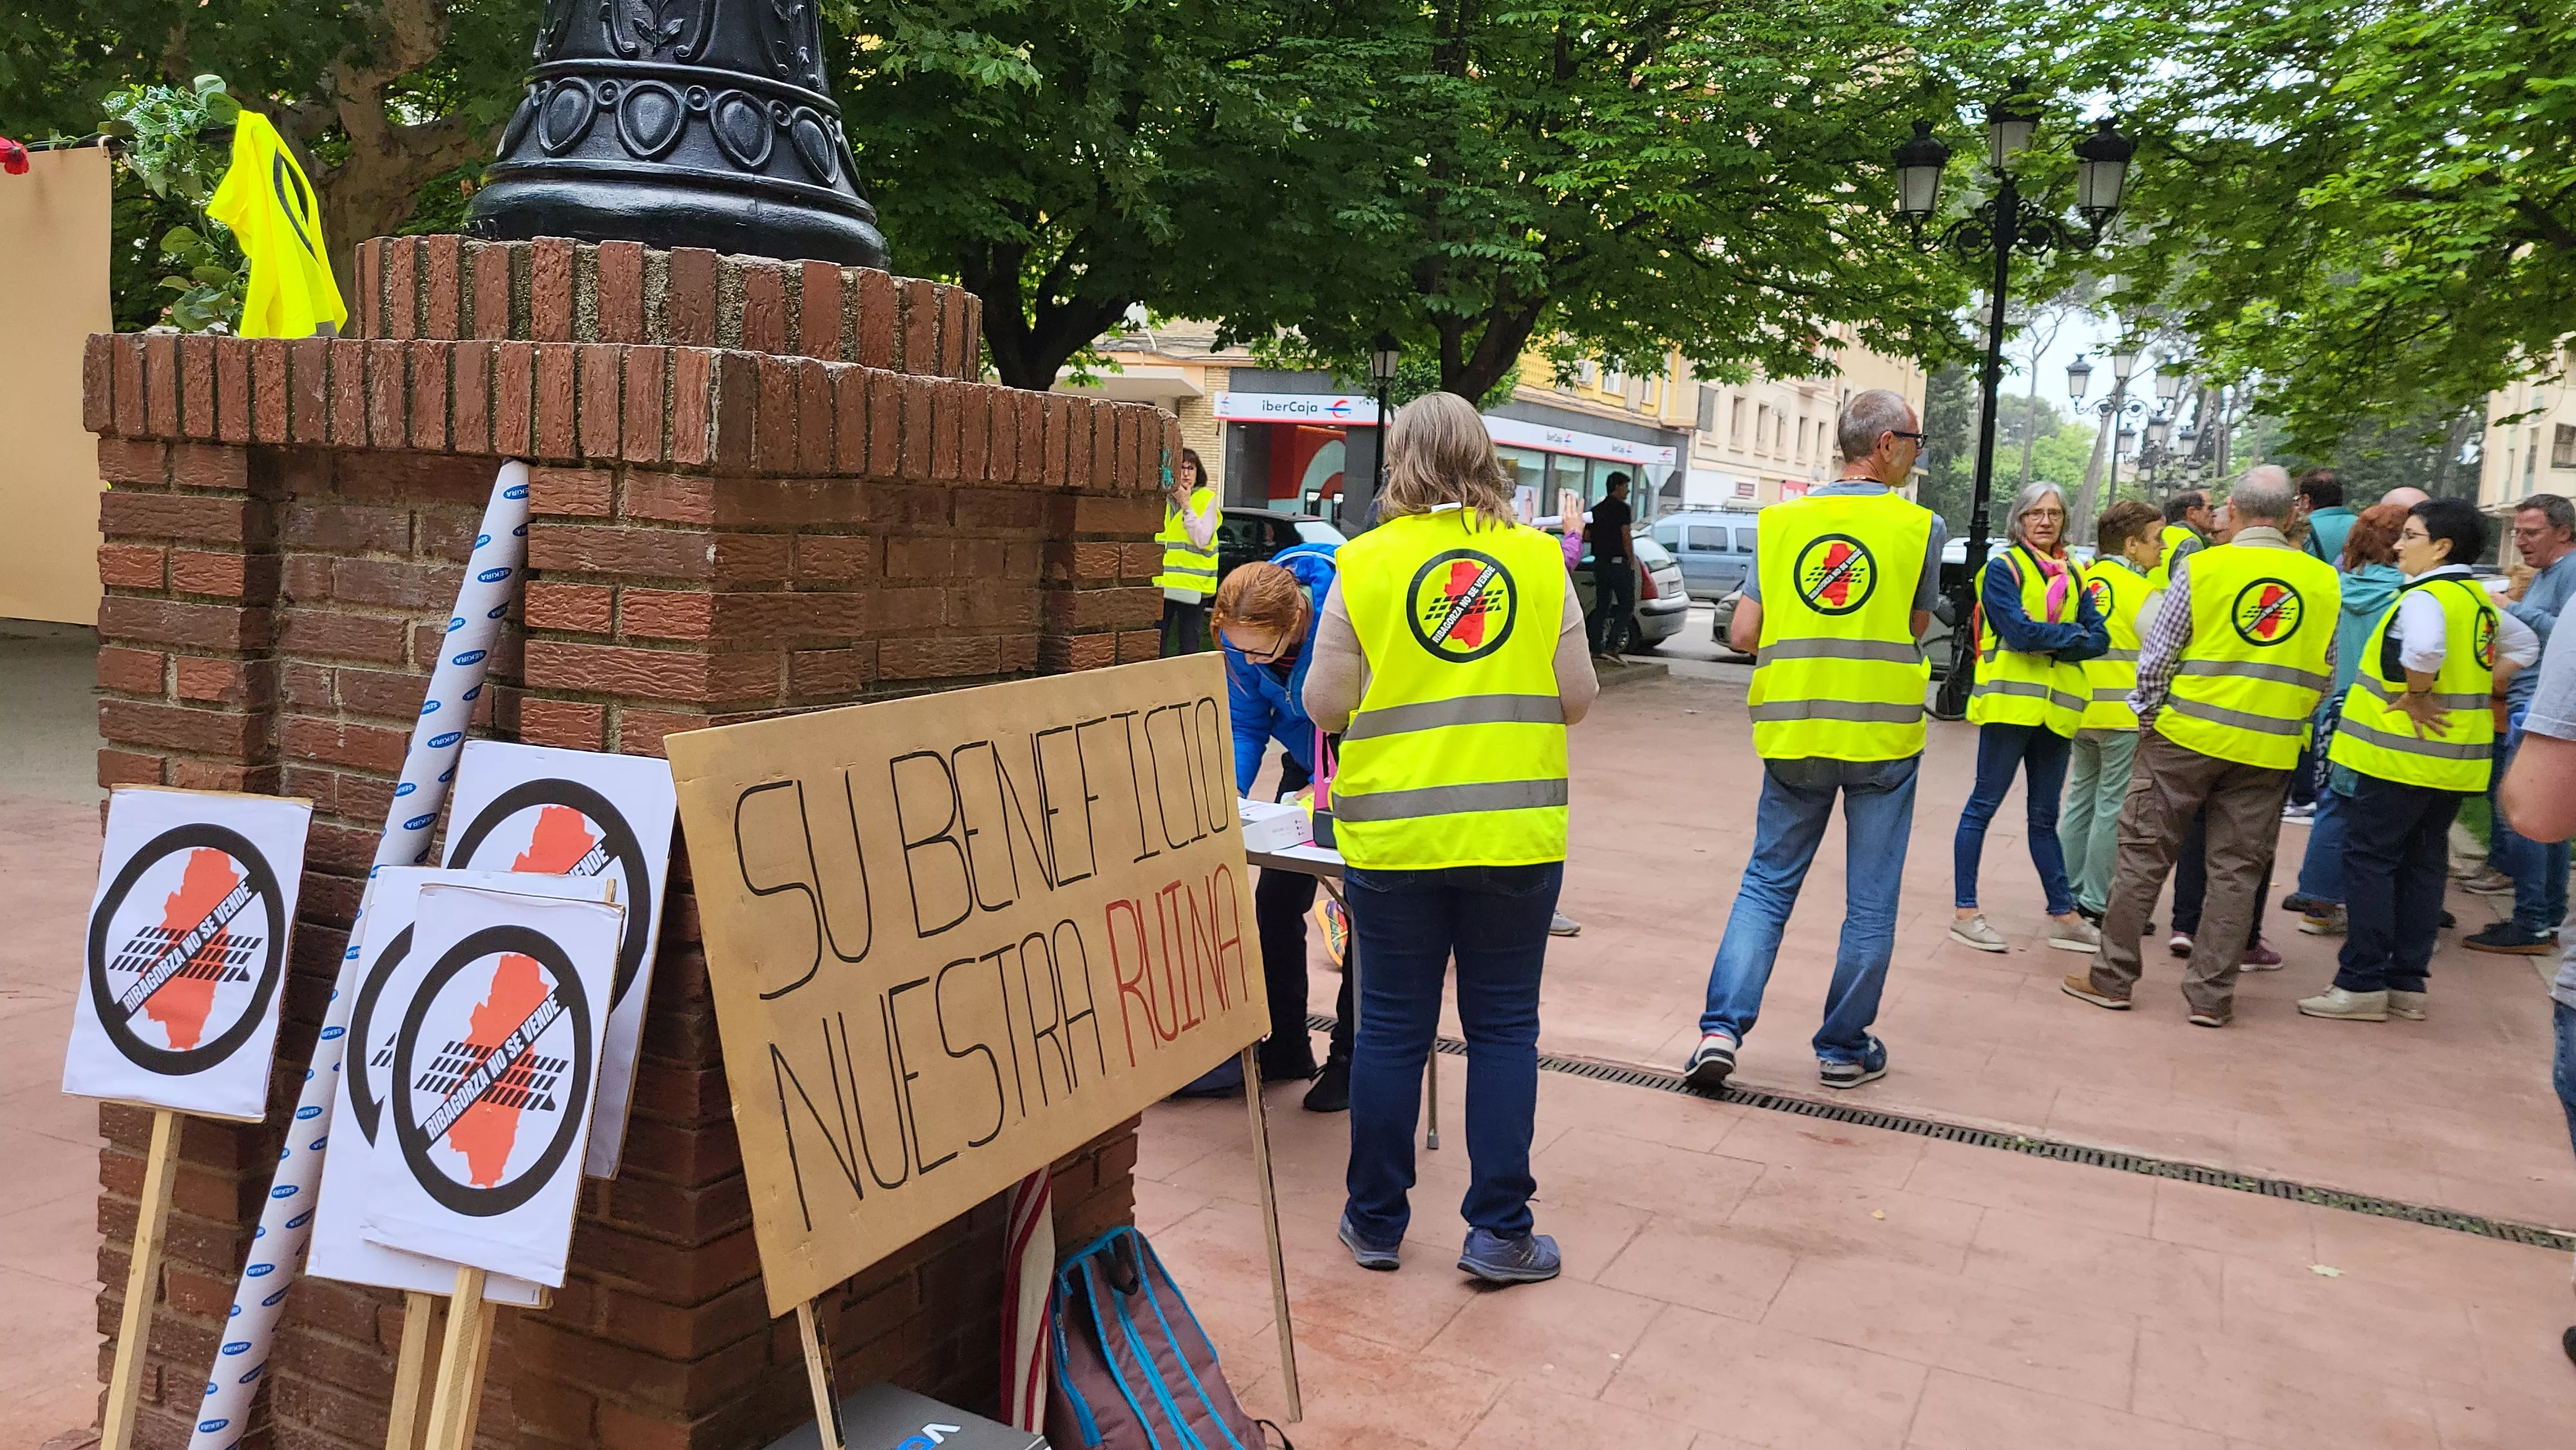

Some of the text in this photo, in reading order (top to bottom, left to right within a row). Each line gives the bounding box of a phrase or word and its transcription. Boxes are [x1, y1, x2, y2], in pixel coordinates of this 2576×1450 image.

[1262, 400, 1318, 415] iberCaja
[506, 487, 529, 498] EKIRA
[1432, 565, 1496, 643] RIBAGORZA NO SE VENDE
[567, 843, 610, 876] ENDE
[734, 696, 1229, 1000] SU BENEFICIO
[122, 880, 252, 1013] RIBAGORZA NO SE VENDE
[423, 993, 561, 1142] RIBAGORZA NO SE VENDE
[769, 863, 1249, 1232] NUESTRA RUINA
